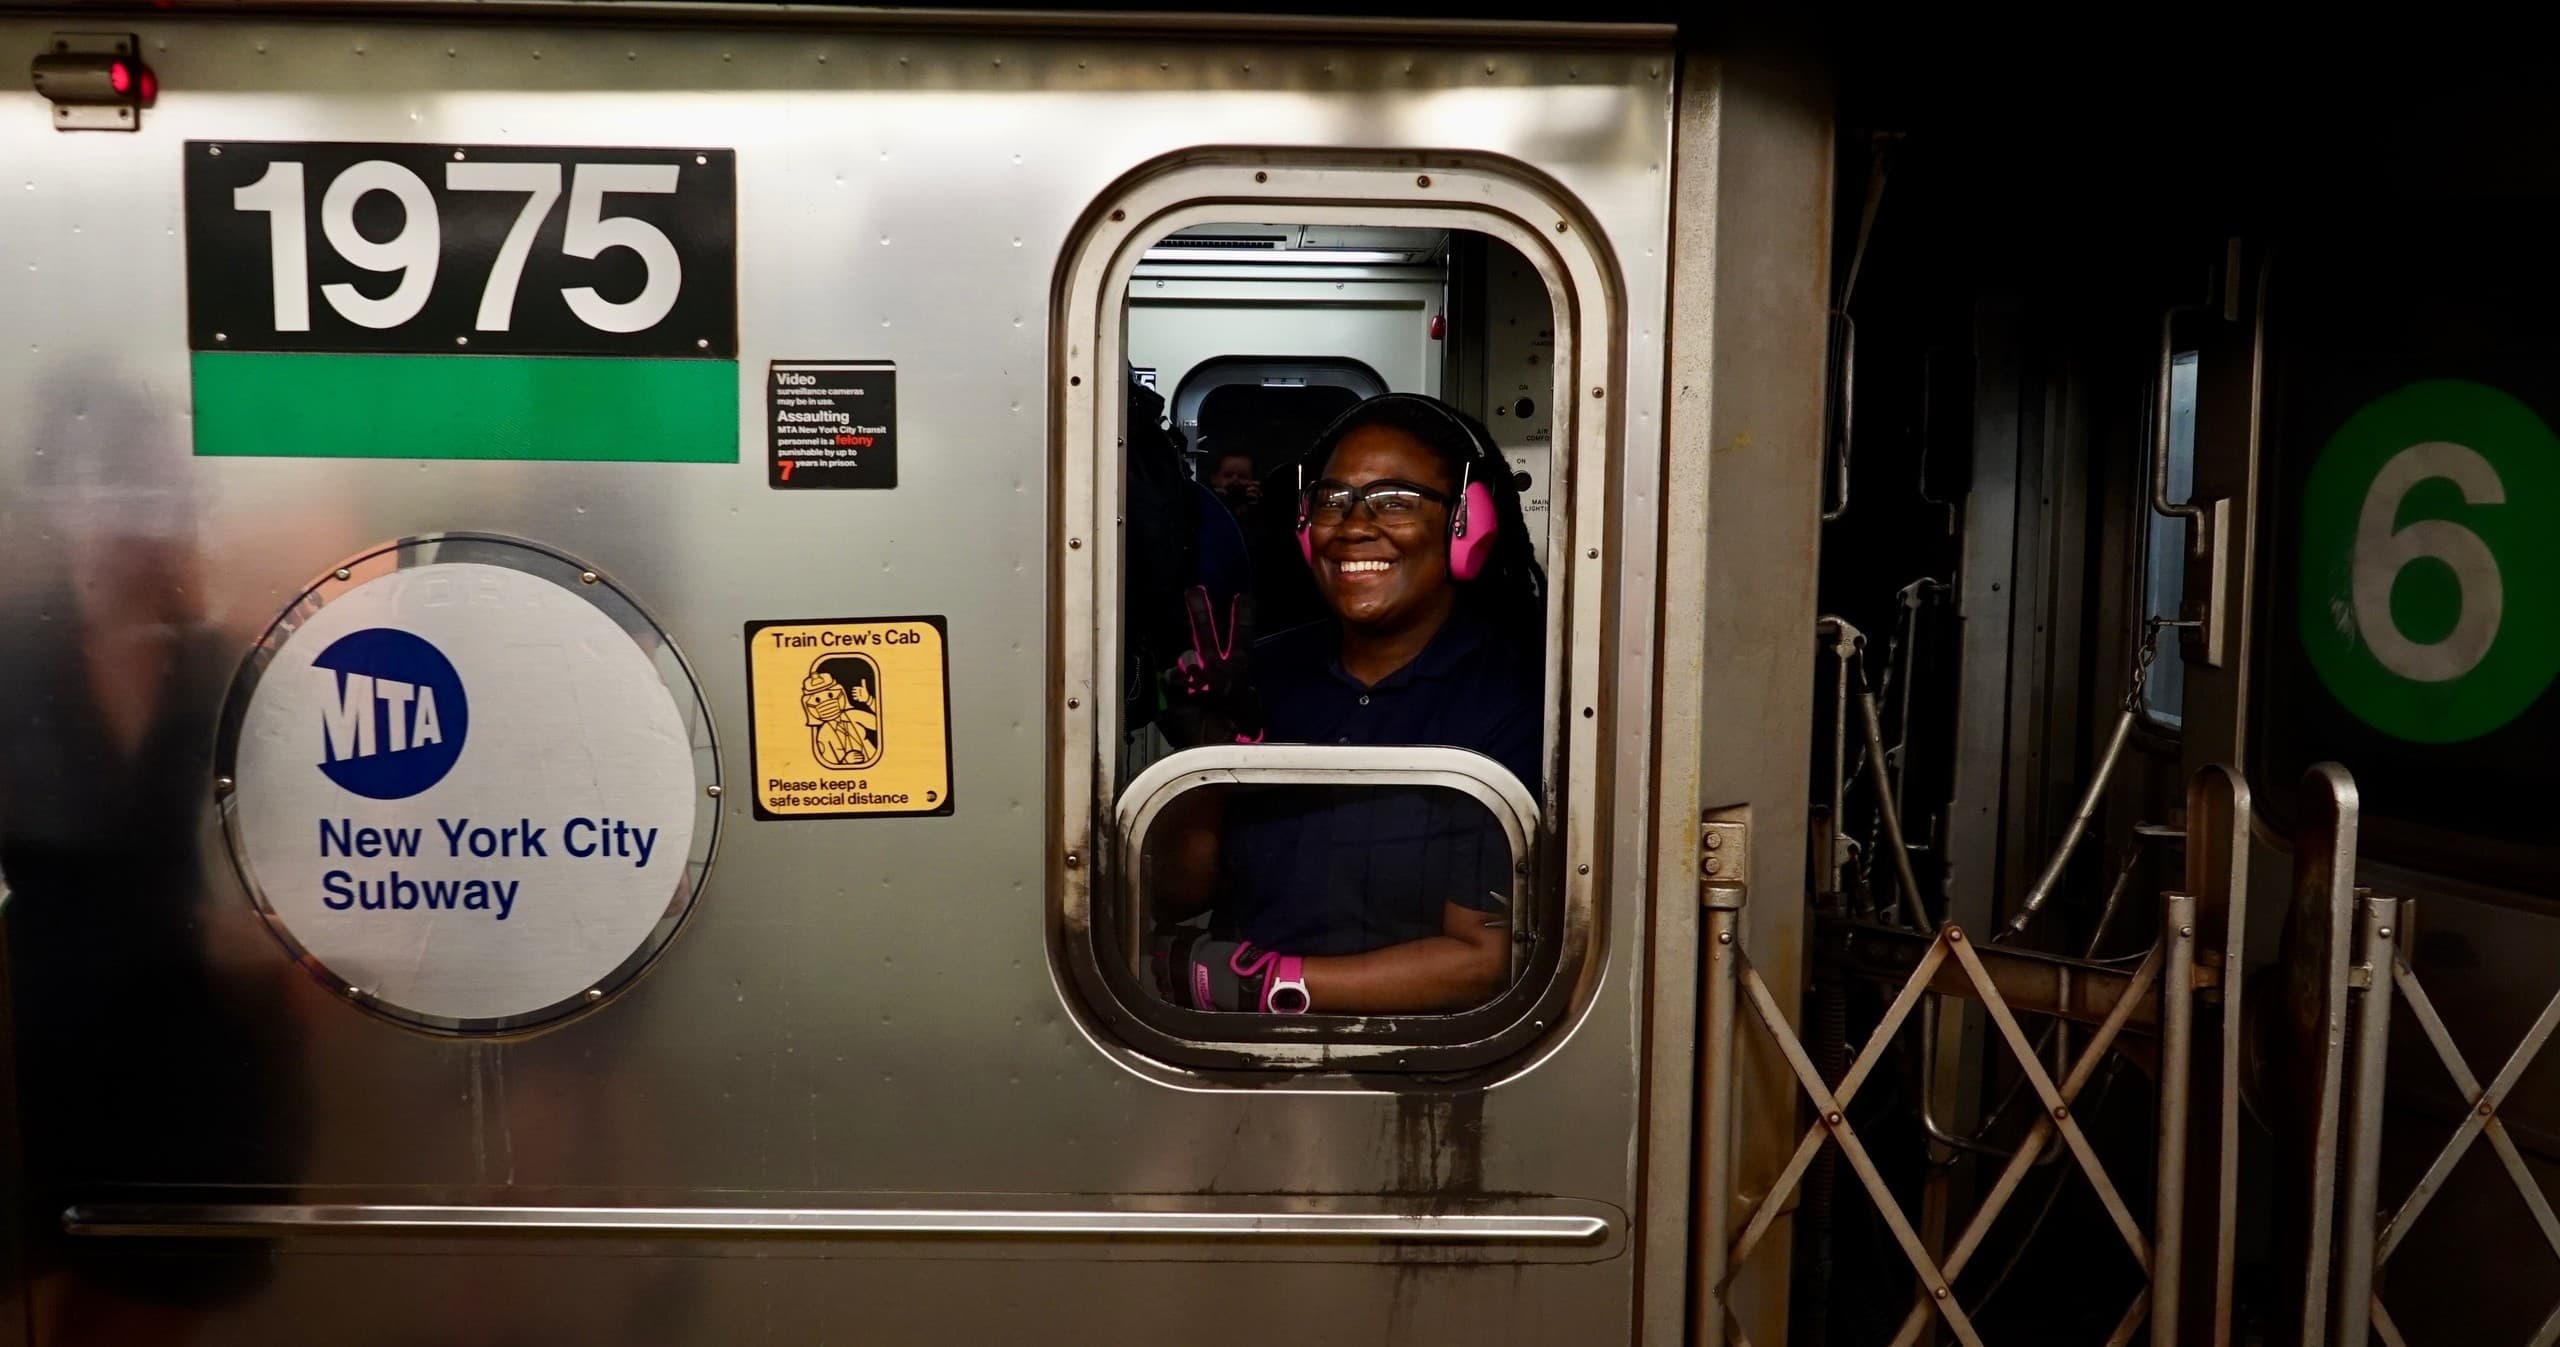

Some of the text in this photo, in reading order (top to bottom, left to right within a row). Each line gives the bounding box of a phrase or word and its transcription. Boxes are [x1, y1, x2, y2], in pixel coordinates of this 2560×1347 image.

[234, 160, 682, 333] 1975
[776, 373, 816, 385] Video
[776, 387, 864, 396] surveillance cameras
[777, 410, 850, 425] Assaulting
[839, 426, 856, 435] City
[857, 426, 887, 434] Transit
[778, 438, 819, 446] personnel
[835, 435, 873, 447] felony
[778, 449, 823, 457] punishable
[824, 449, 835, 457] by
[778, 460, 795, 481] 7
[829, 460, 857, 468] prison.
[2352, 441, 2506, 682] 6
[772, 629, 920, 648] Train Crew's Cab
[312, 666, 443, 763] MTA
[769, 778, 867, 792] Please keep a
[769, 792, 909, 807] safe social distance
[319, 817, 658, 867] New York City
[322, 870, 520, 920] Subway
